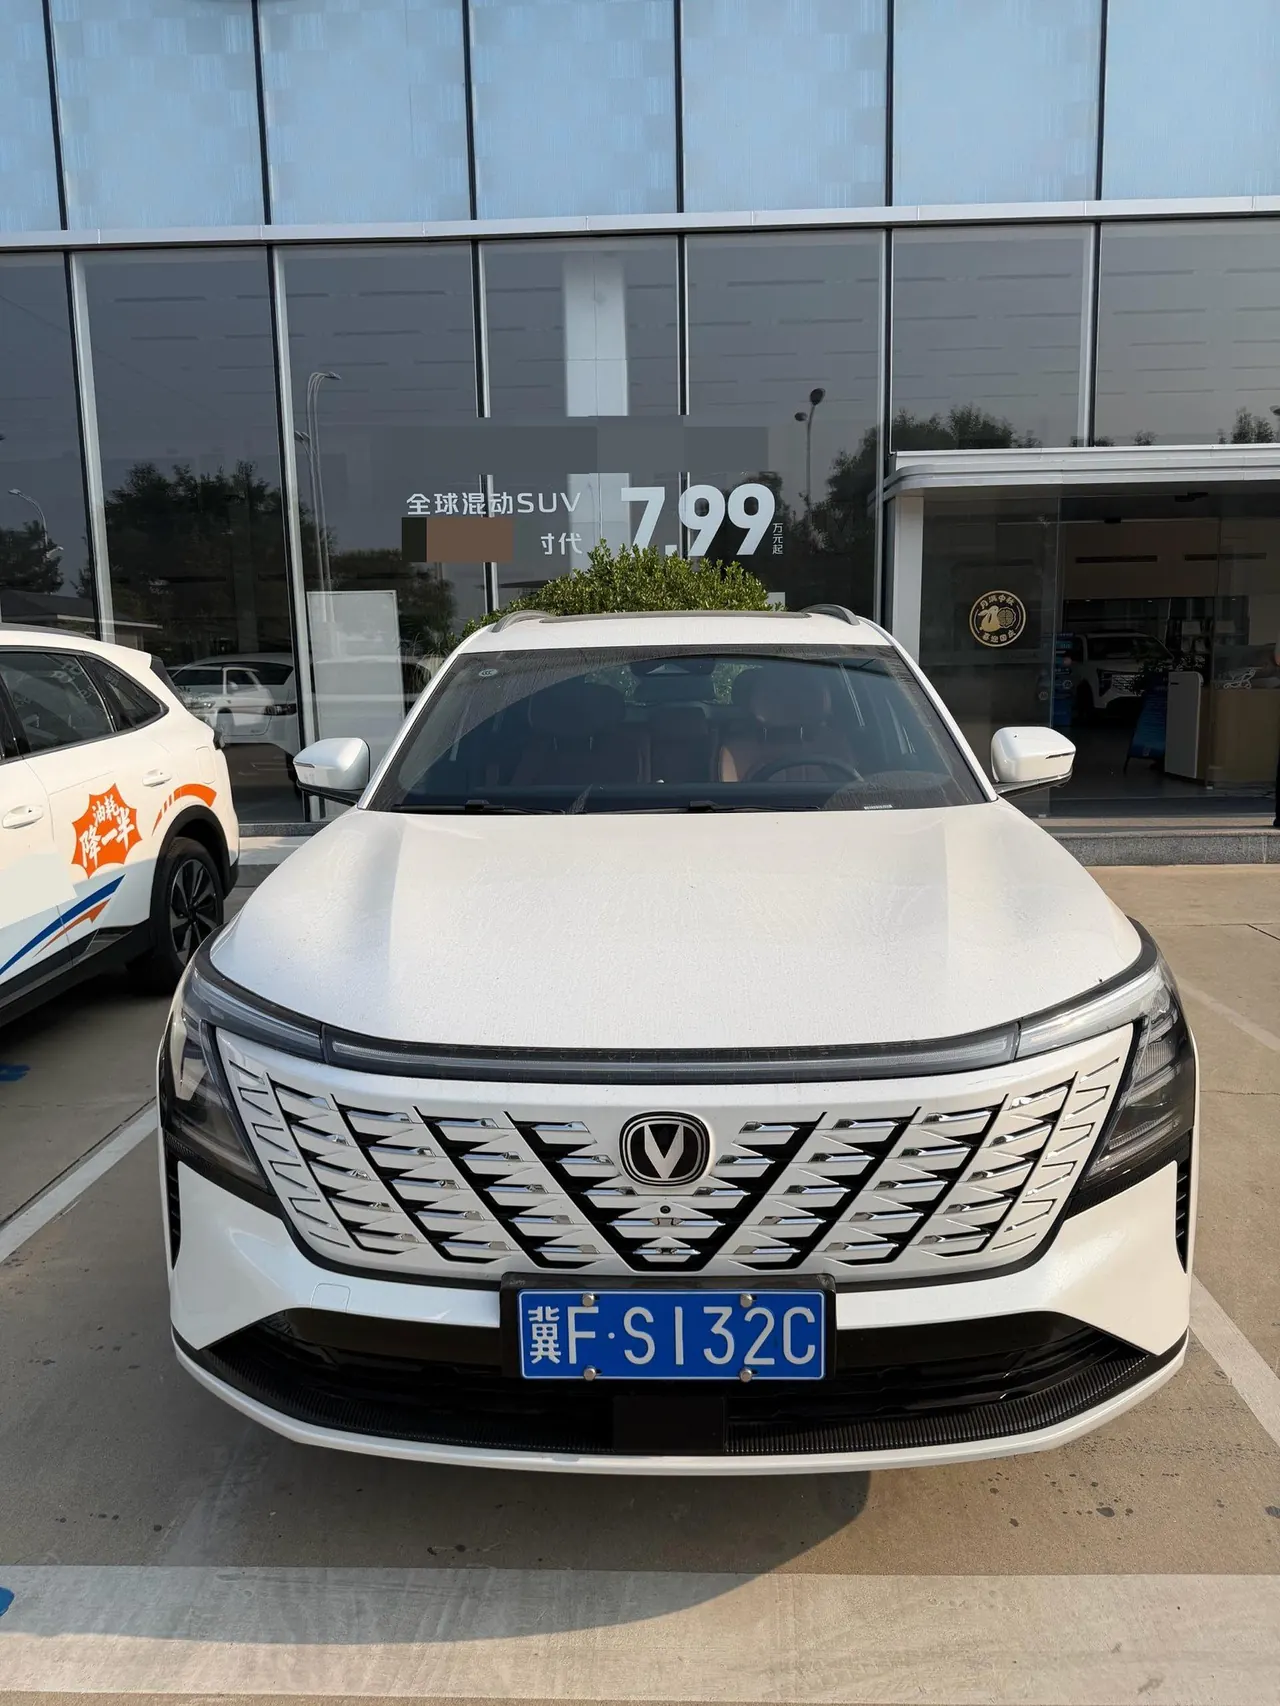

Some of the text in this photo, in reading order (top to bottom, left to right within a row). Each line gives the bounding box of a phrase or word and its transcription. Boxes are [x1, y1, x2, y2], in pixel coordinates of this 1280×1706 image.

[406, 491, 581, 515] 全球混动SUV
[621, 483, 775, 557] 7.99
[772, 522, 784, 555] 万元起
[92, 794, 120, 828] 油耗
[79, 806, 135, 869] 降一半
[528, 1306, 816, 1365] 冀F·S132C
